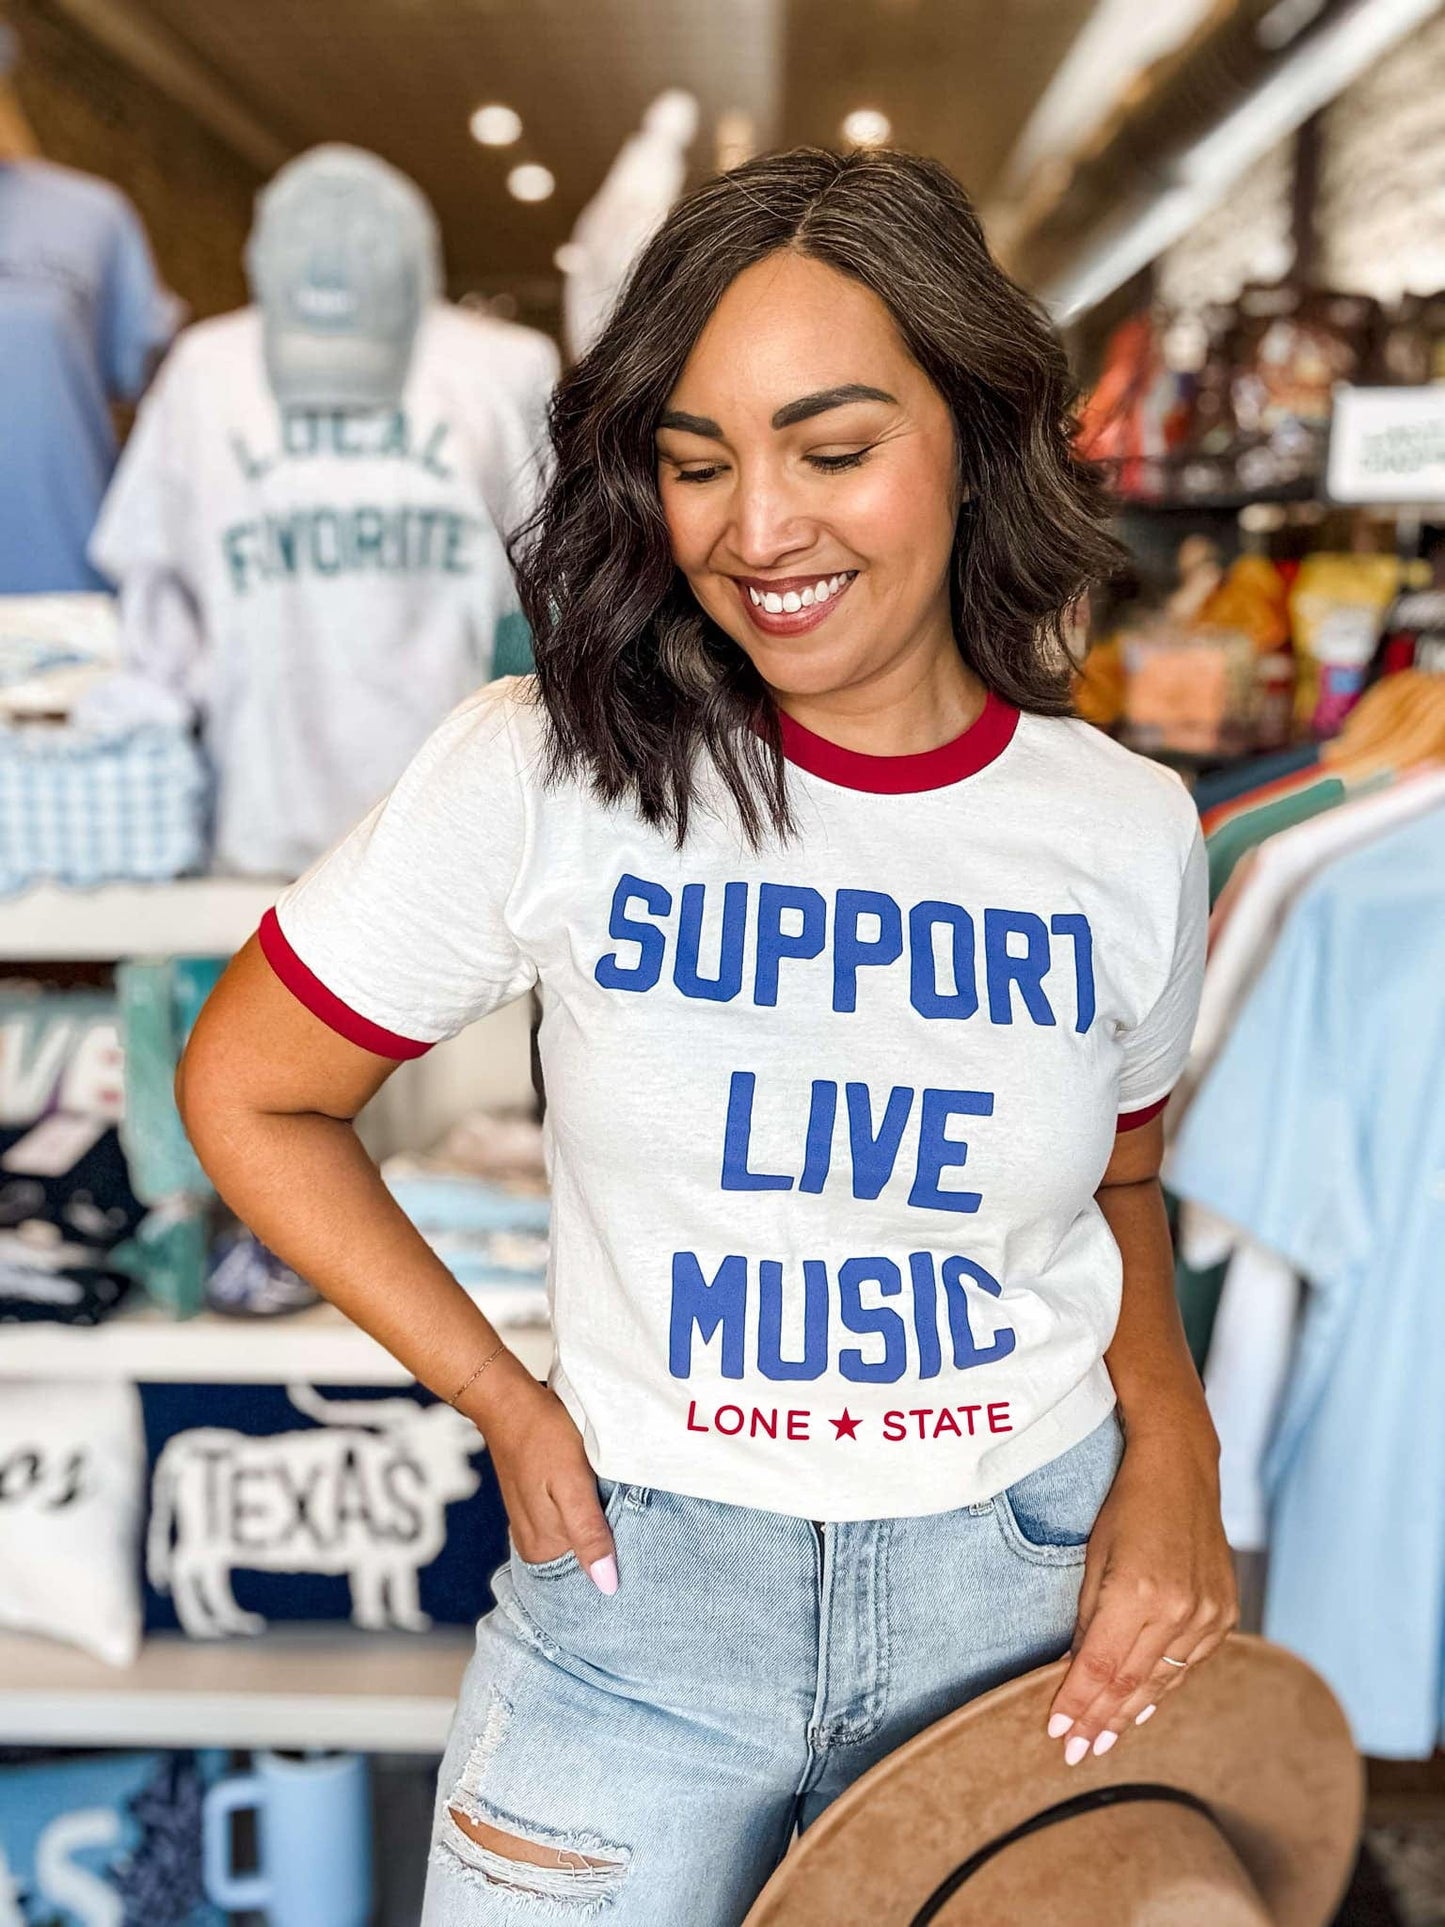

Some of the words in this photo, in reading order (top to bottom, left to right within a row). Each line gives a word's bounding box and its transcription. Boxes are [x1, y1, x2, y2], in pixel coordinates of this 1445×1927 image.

[228, 408, 454, 480] LOCAL
[594, 873, 1096, 1034] SUPPORT
[720, 1070, 994, 1214] LIVE
[668, 1251, 1016, 1384] MUSIC
[686, 1400, 811, 1441] LONE
[882, 1401, 1013, 1442] STATE
[192, 1449, 427, 1547] TEXAS
